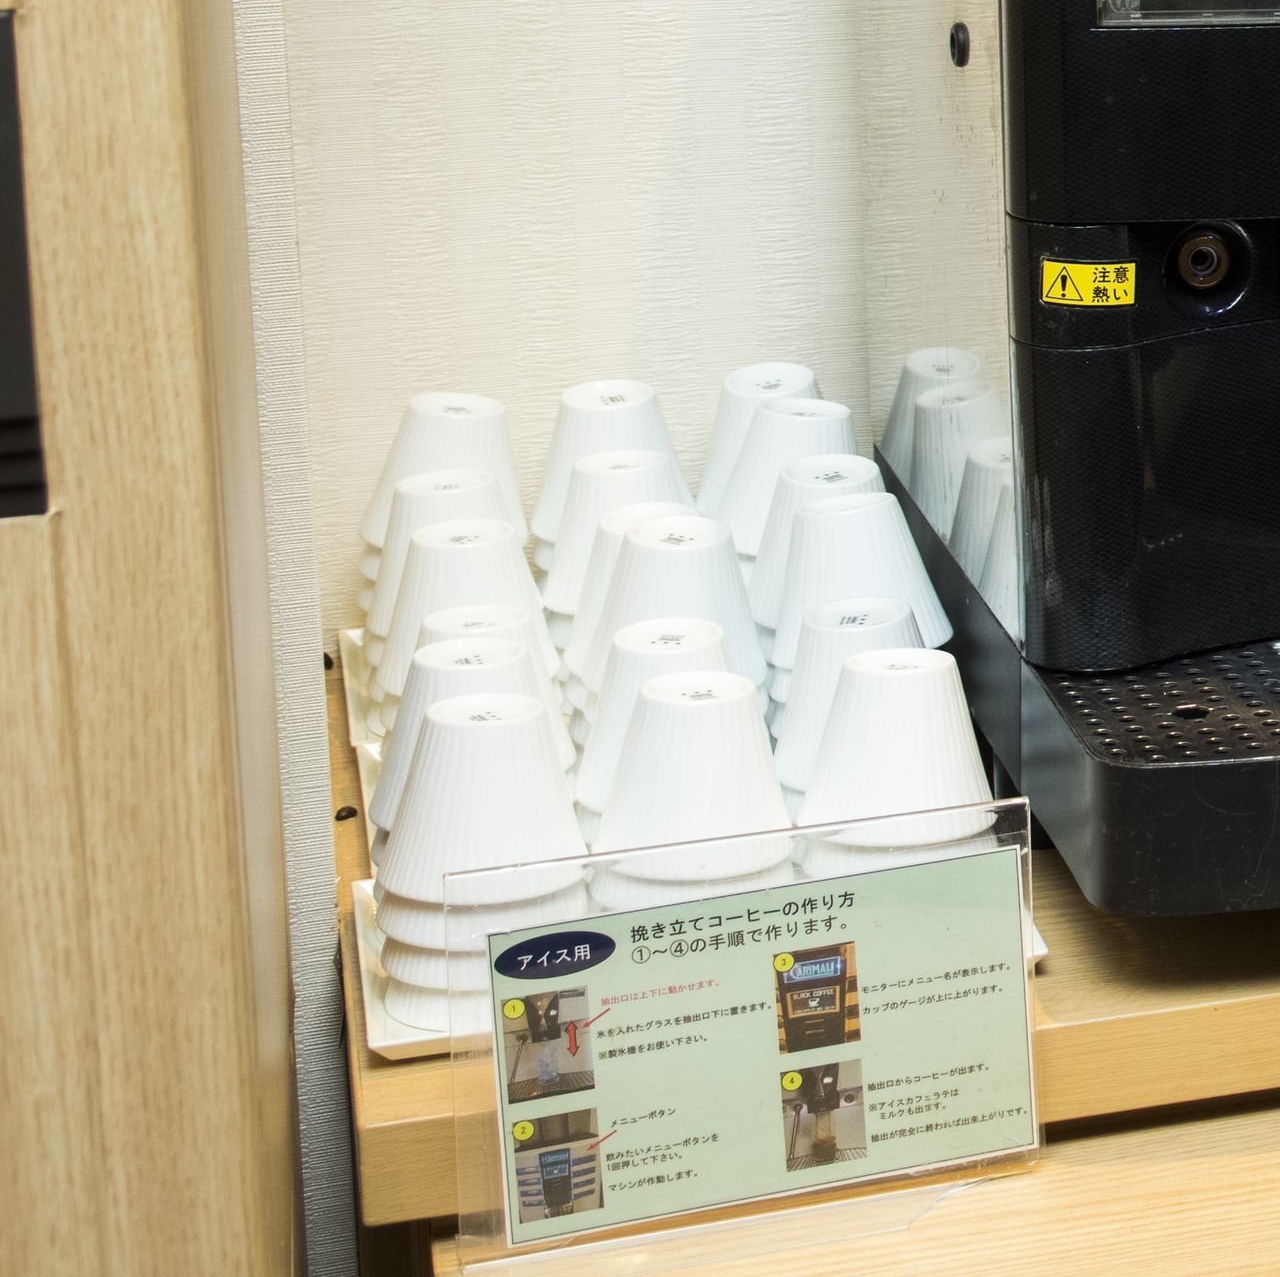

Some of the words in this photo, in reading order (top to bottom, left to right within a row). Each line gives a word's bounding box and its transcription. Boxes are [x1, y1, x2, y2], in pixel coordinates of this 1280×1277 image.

[1092, 266, 1130, 284] 注意
[1092, 286, 1129, 303] 熱い
[630, 891, 856, 944] 挽き立てコーヒーの作り方
[517, 943, 591, 971] アイス用
[610, 1108, 677, 1128] メニューボタン
